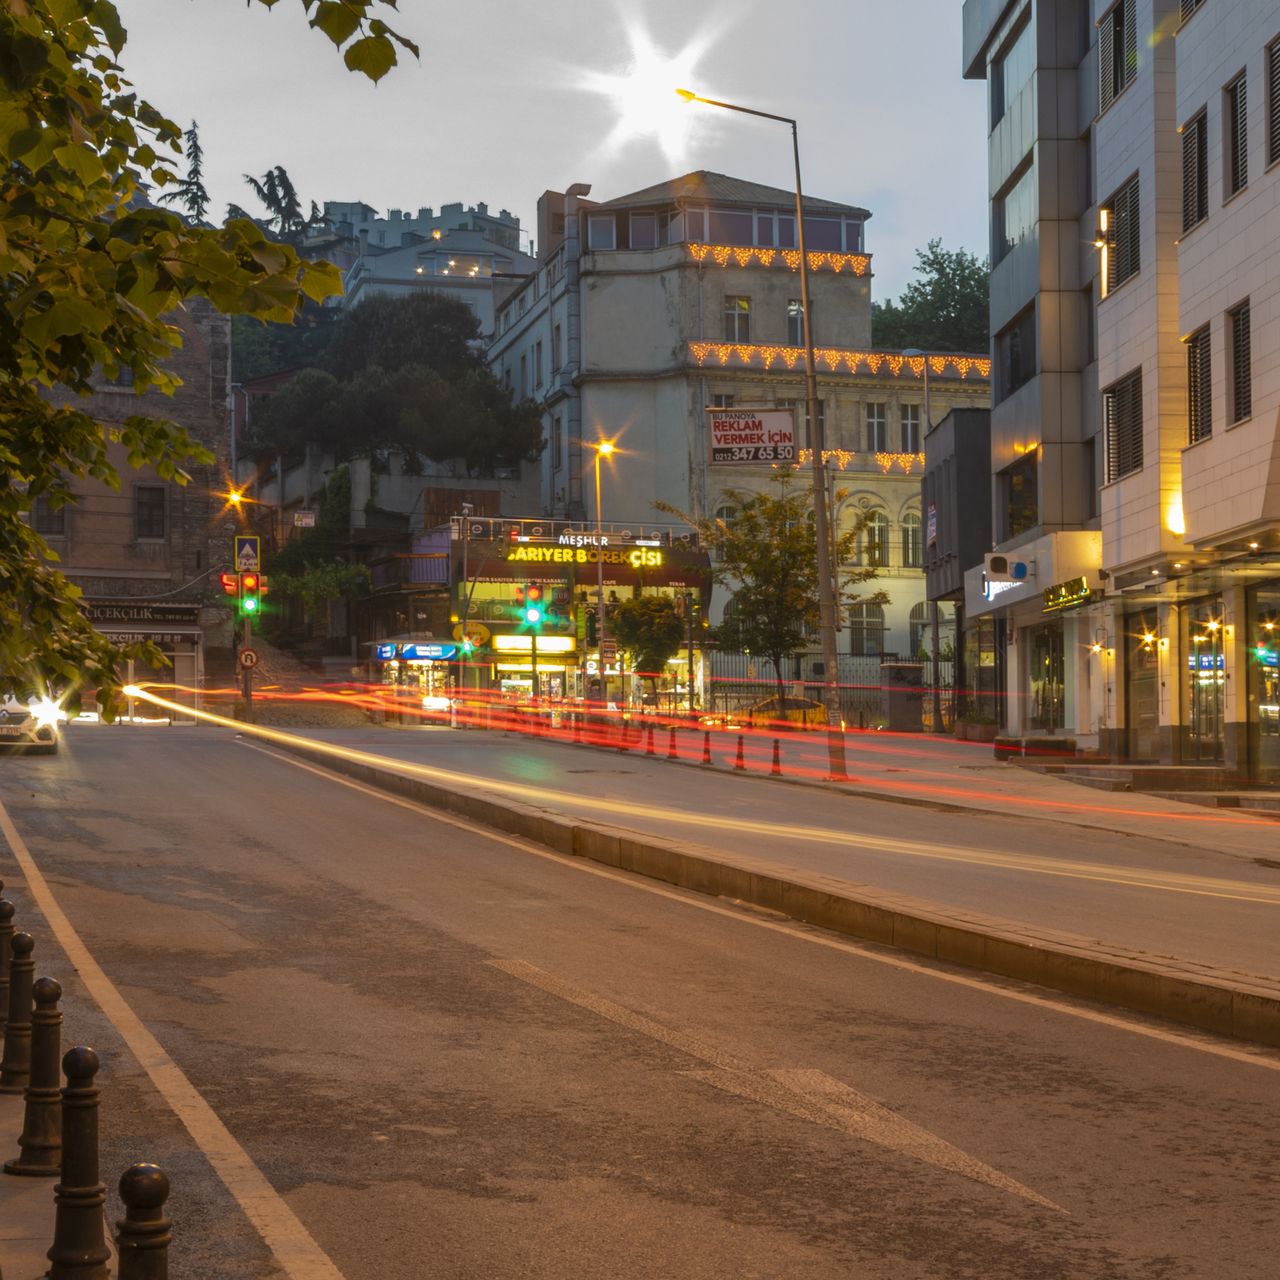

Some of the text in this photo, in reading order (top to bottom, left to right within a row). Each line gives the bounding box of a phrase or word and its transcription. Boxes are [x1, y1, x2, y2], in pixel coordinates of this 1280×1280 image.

[713, 420, 763, 432] REKLAM
[714, 430, 793, 446] VERMEK İÇİN
[732, 448, 755, 460] 347
[758, 447, 774, 459] 65
[777, 447, 793, 459] 50
